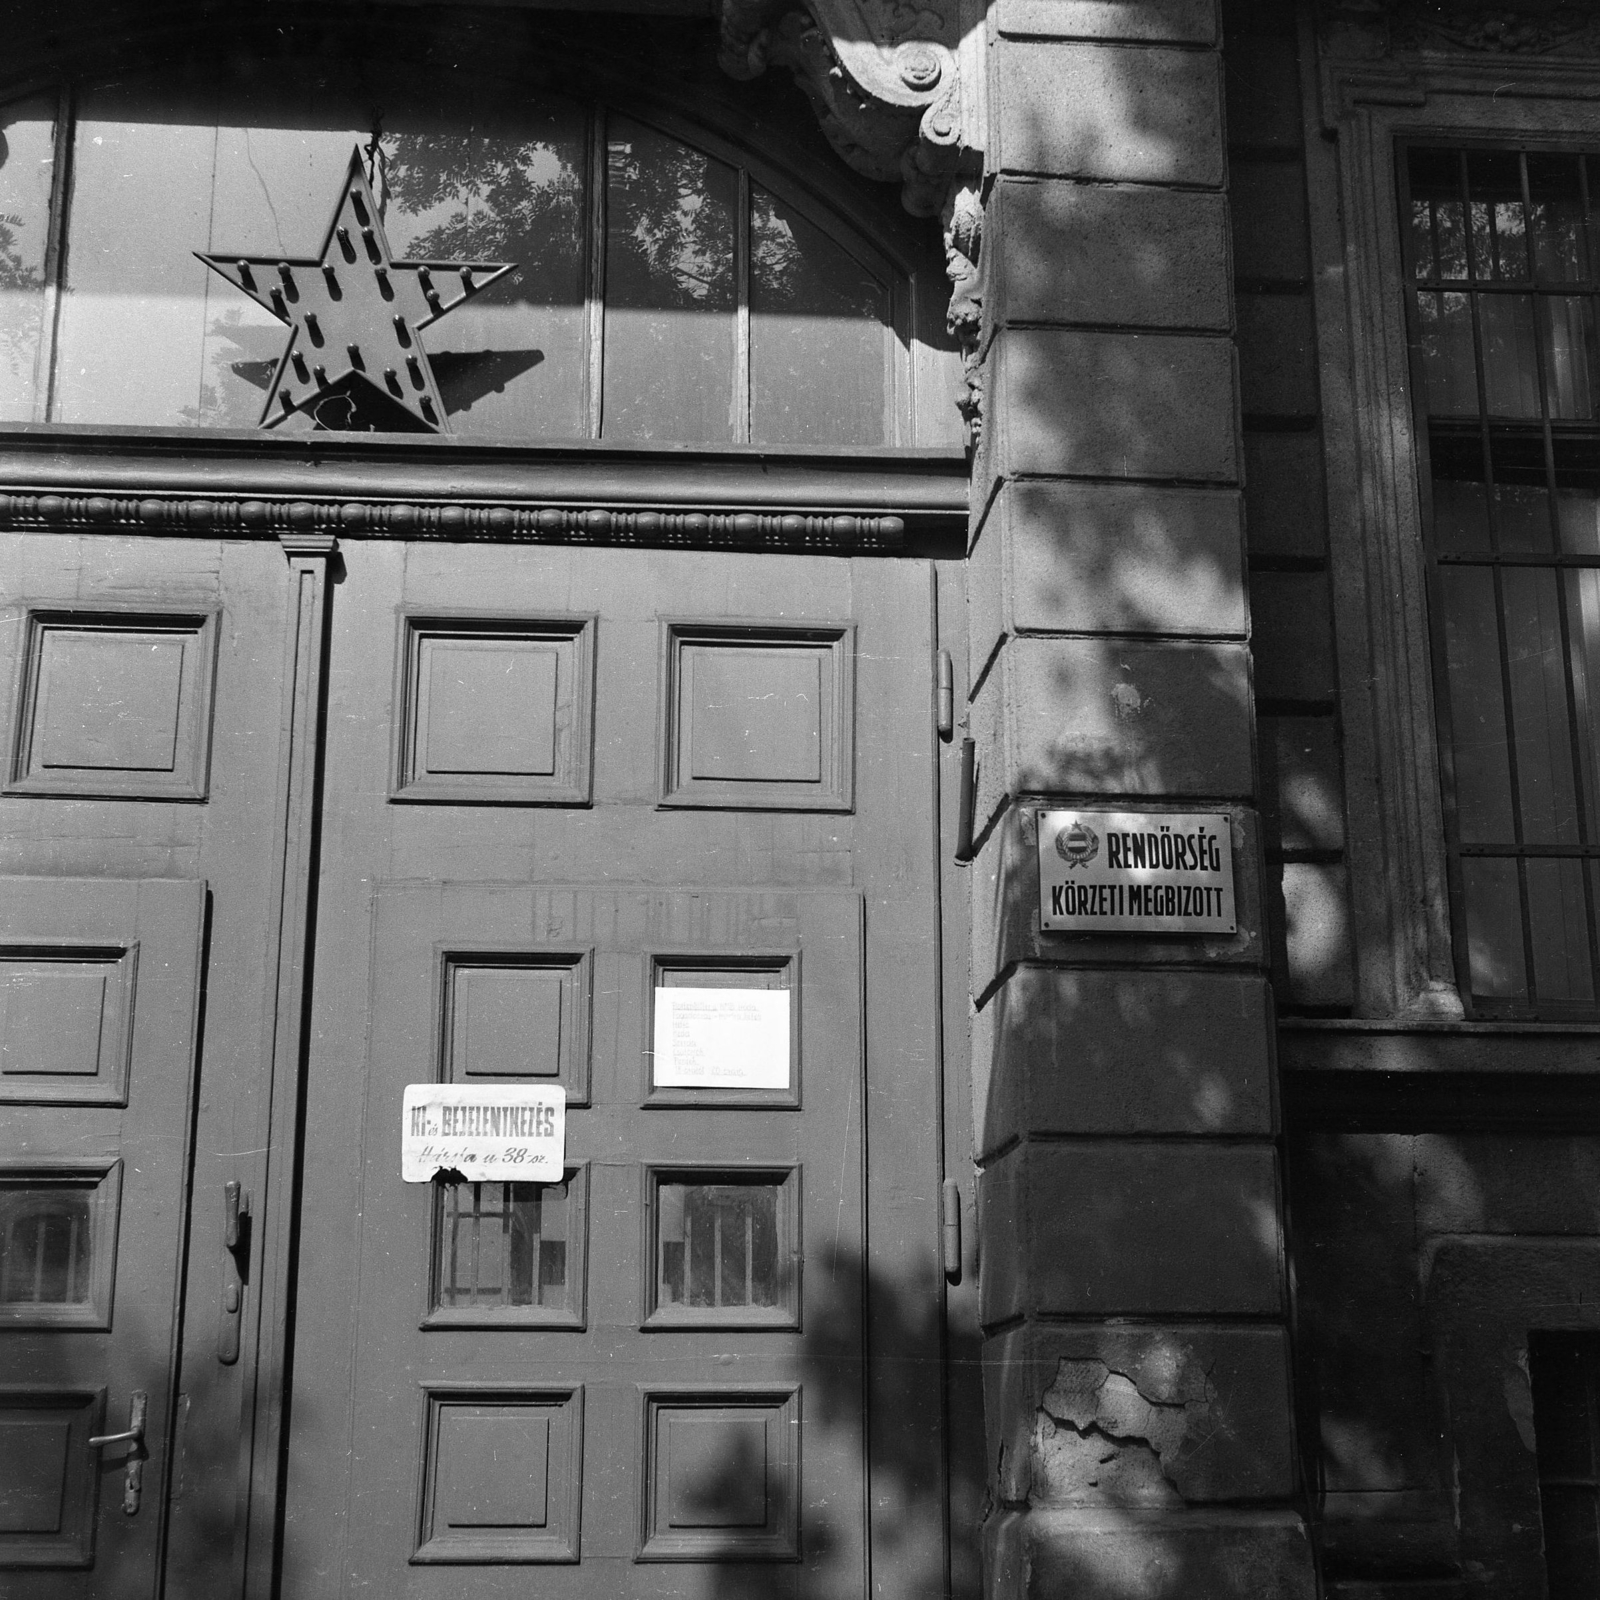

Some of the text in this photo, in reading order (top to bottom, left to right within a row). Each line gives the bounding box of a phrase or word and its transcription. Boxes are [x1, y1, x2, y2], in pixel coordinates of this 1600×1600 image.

[1052, 880, 1224, 918] KÖRZETI MEGBIZOTT
[441, 1101, 555, 1138] BEJELENTKEZÉS
